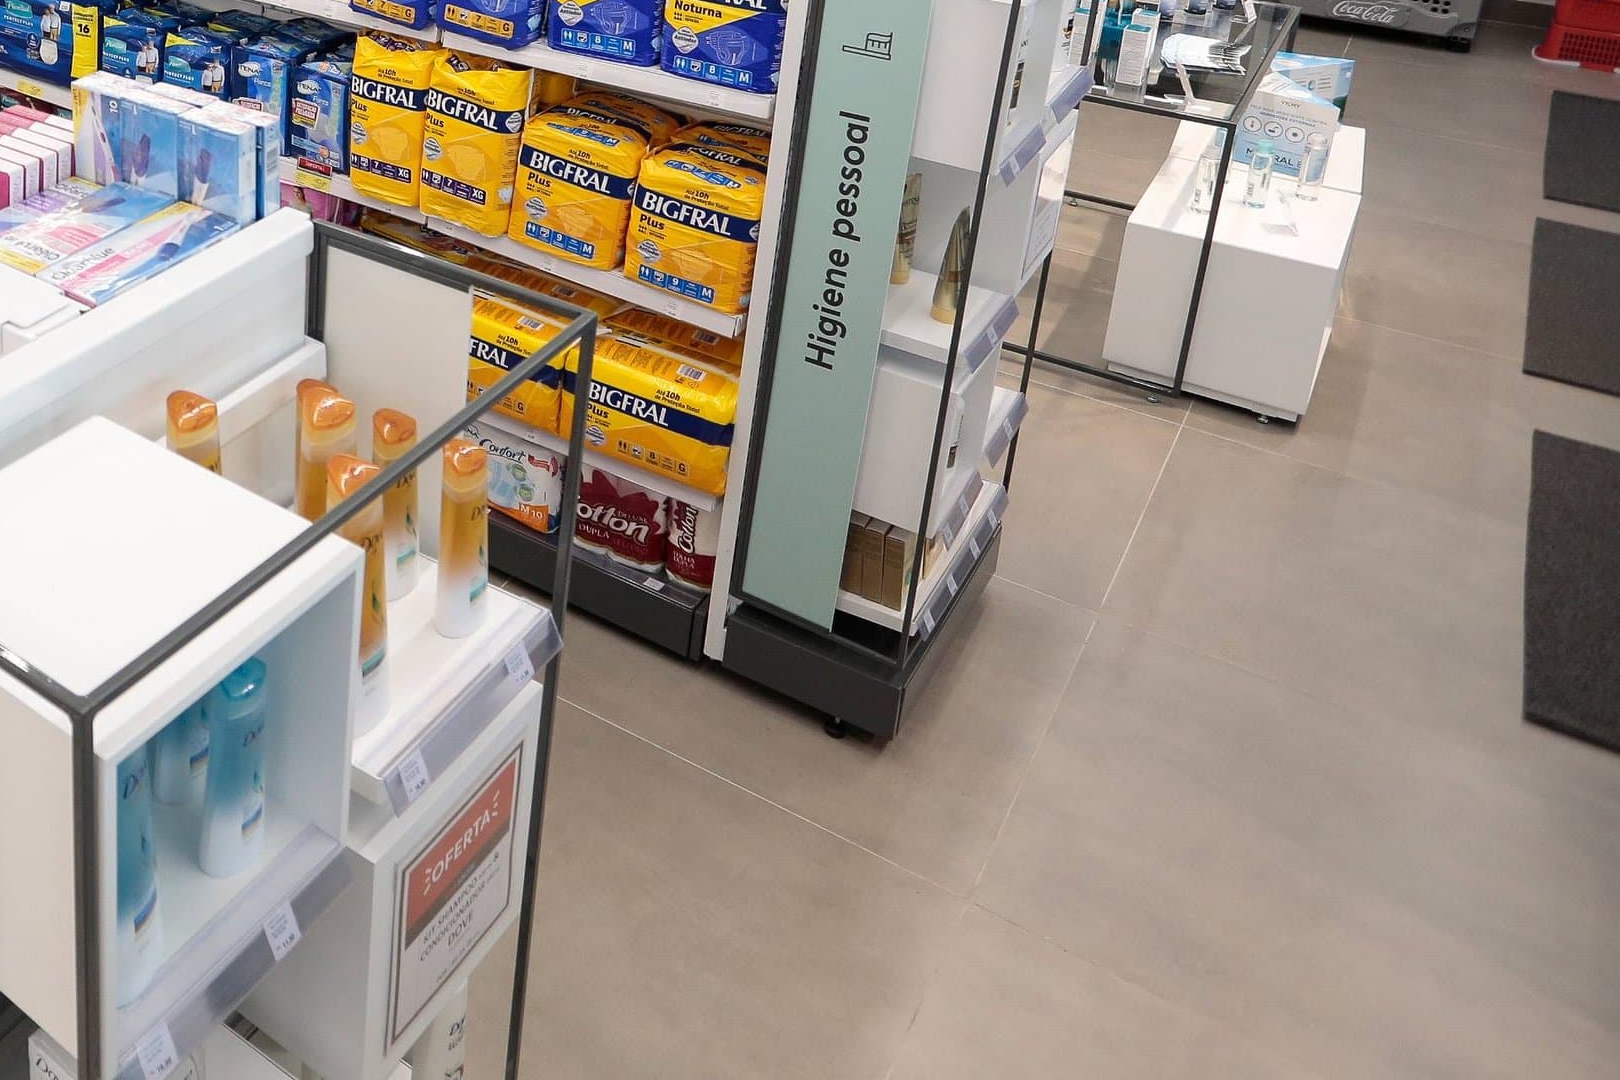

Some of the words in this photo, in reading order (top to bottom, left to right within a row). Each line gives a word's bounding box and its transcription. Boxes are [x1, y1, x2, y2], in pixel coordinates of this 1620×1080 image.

[674, 0, 722, 20] Noturna
[78, 23, 90, 34] 16
[502, 22, 510, 32] G
[623, 41, 633, 52] M
[738, 71, 750, 84] M
[352, 76, 417, 109] BIGFRAL
[427, 90, 498, 131] BIGFRAL
[527, 172, 551, 189] Plus
[530, 151, 611, 195] BIGFRAL
[831, 110, 871, 243] pessoal
[639, 213, 665, 231] Plus
[642, 191, 731, 237] BIGFRAL
[582, 243, 592, 255] M
[701, 287, 712, 300] M
[804, 248, 851, 371] Higiene
[589, 382, 669, 427] BIGFRAL
[481, 438, 527, 464] Confort
[577, 505, 651, 545] otton
[431, 810, 491, 883] OFERTA
[447, 911, 474, 949] DOVE
